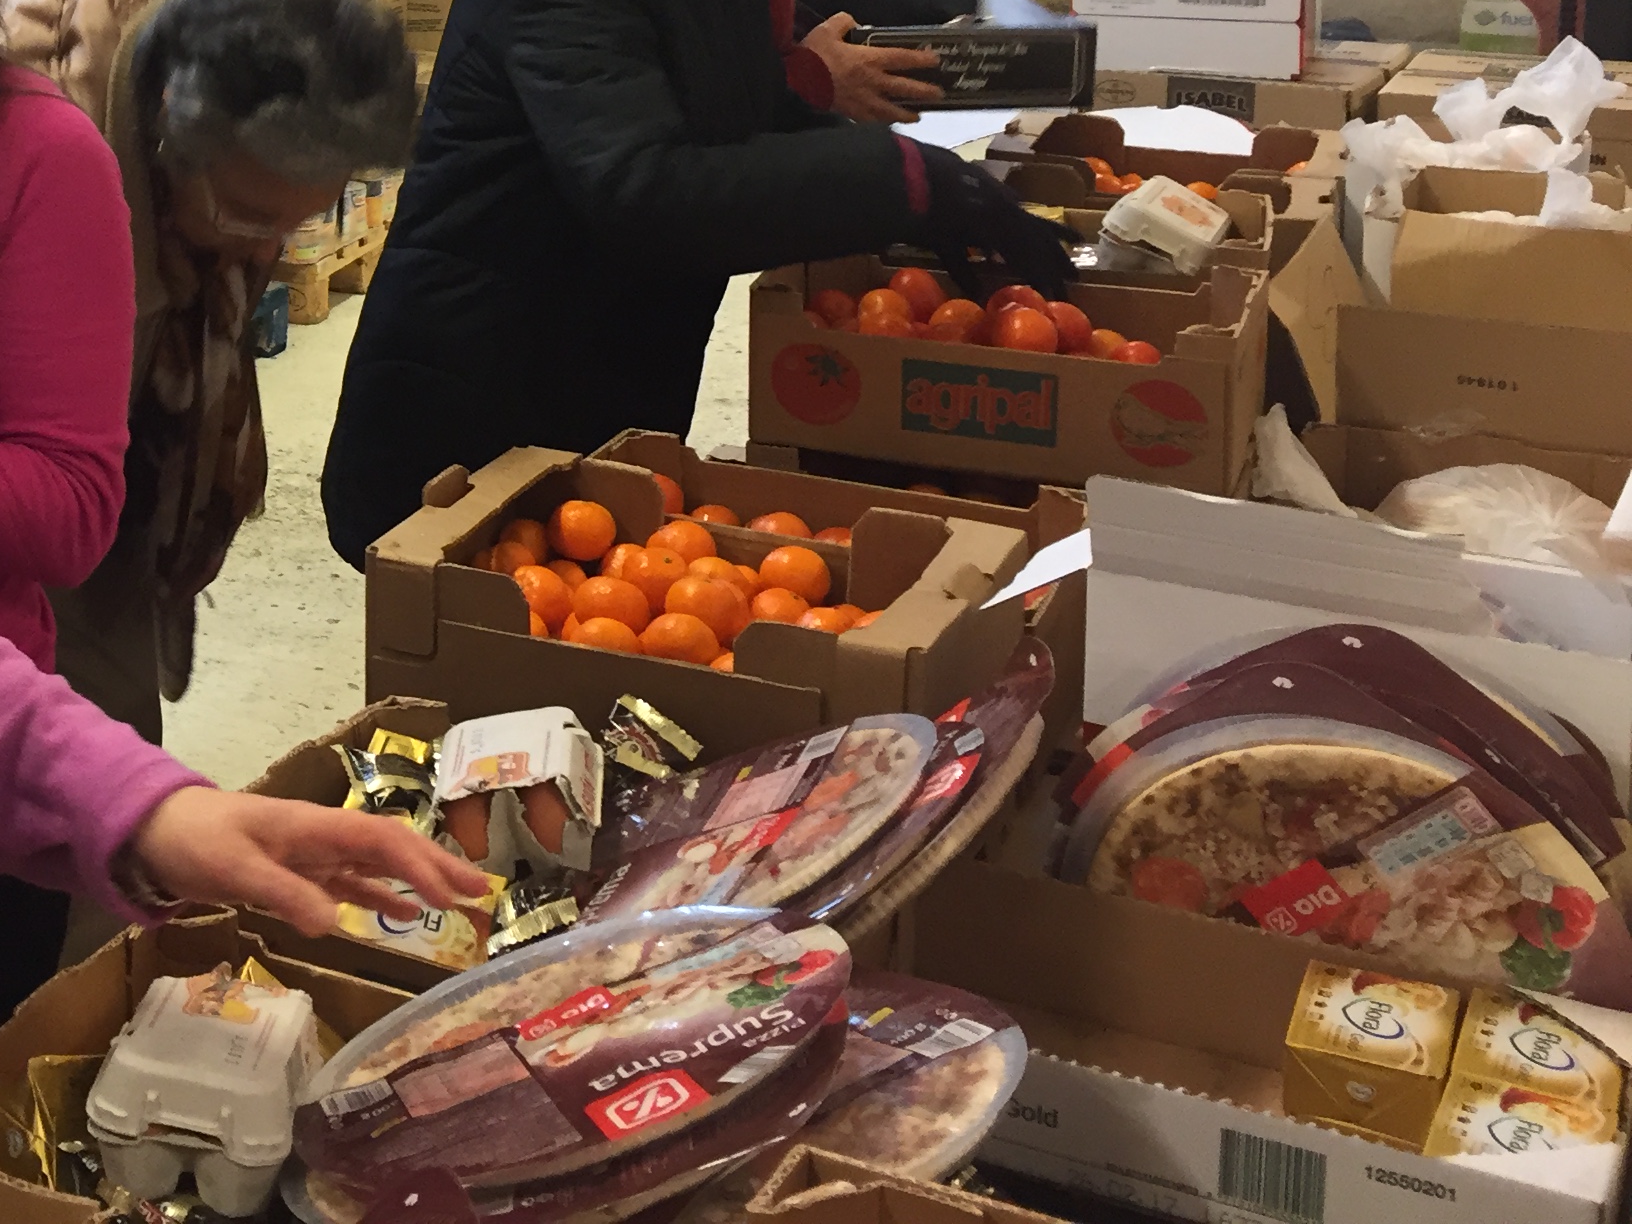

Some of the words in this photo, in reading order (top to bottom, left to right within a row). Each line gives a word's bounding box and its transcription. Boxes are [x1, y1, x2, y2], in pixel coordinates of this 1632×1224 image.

[1176, 90, 1247, 112] ISABEL
[905, 373, 1054, 434] agripal
[1362, 999, 1394, 1031] Flora
[587, 1002, 795, 1093] Suprema
[1530, 1030, 1563, 1062] Flora
[1509, 1119, 1544, 1151] Flora
[1364, 1165, 1457, 1204] 12550201
